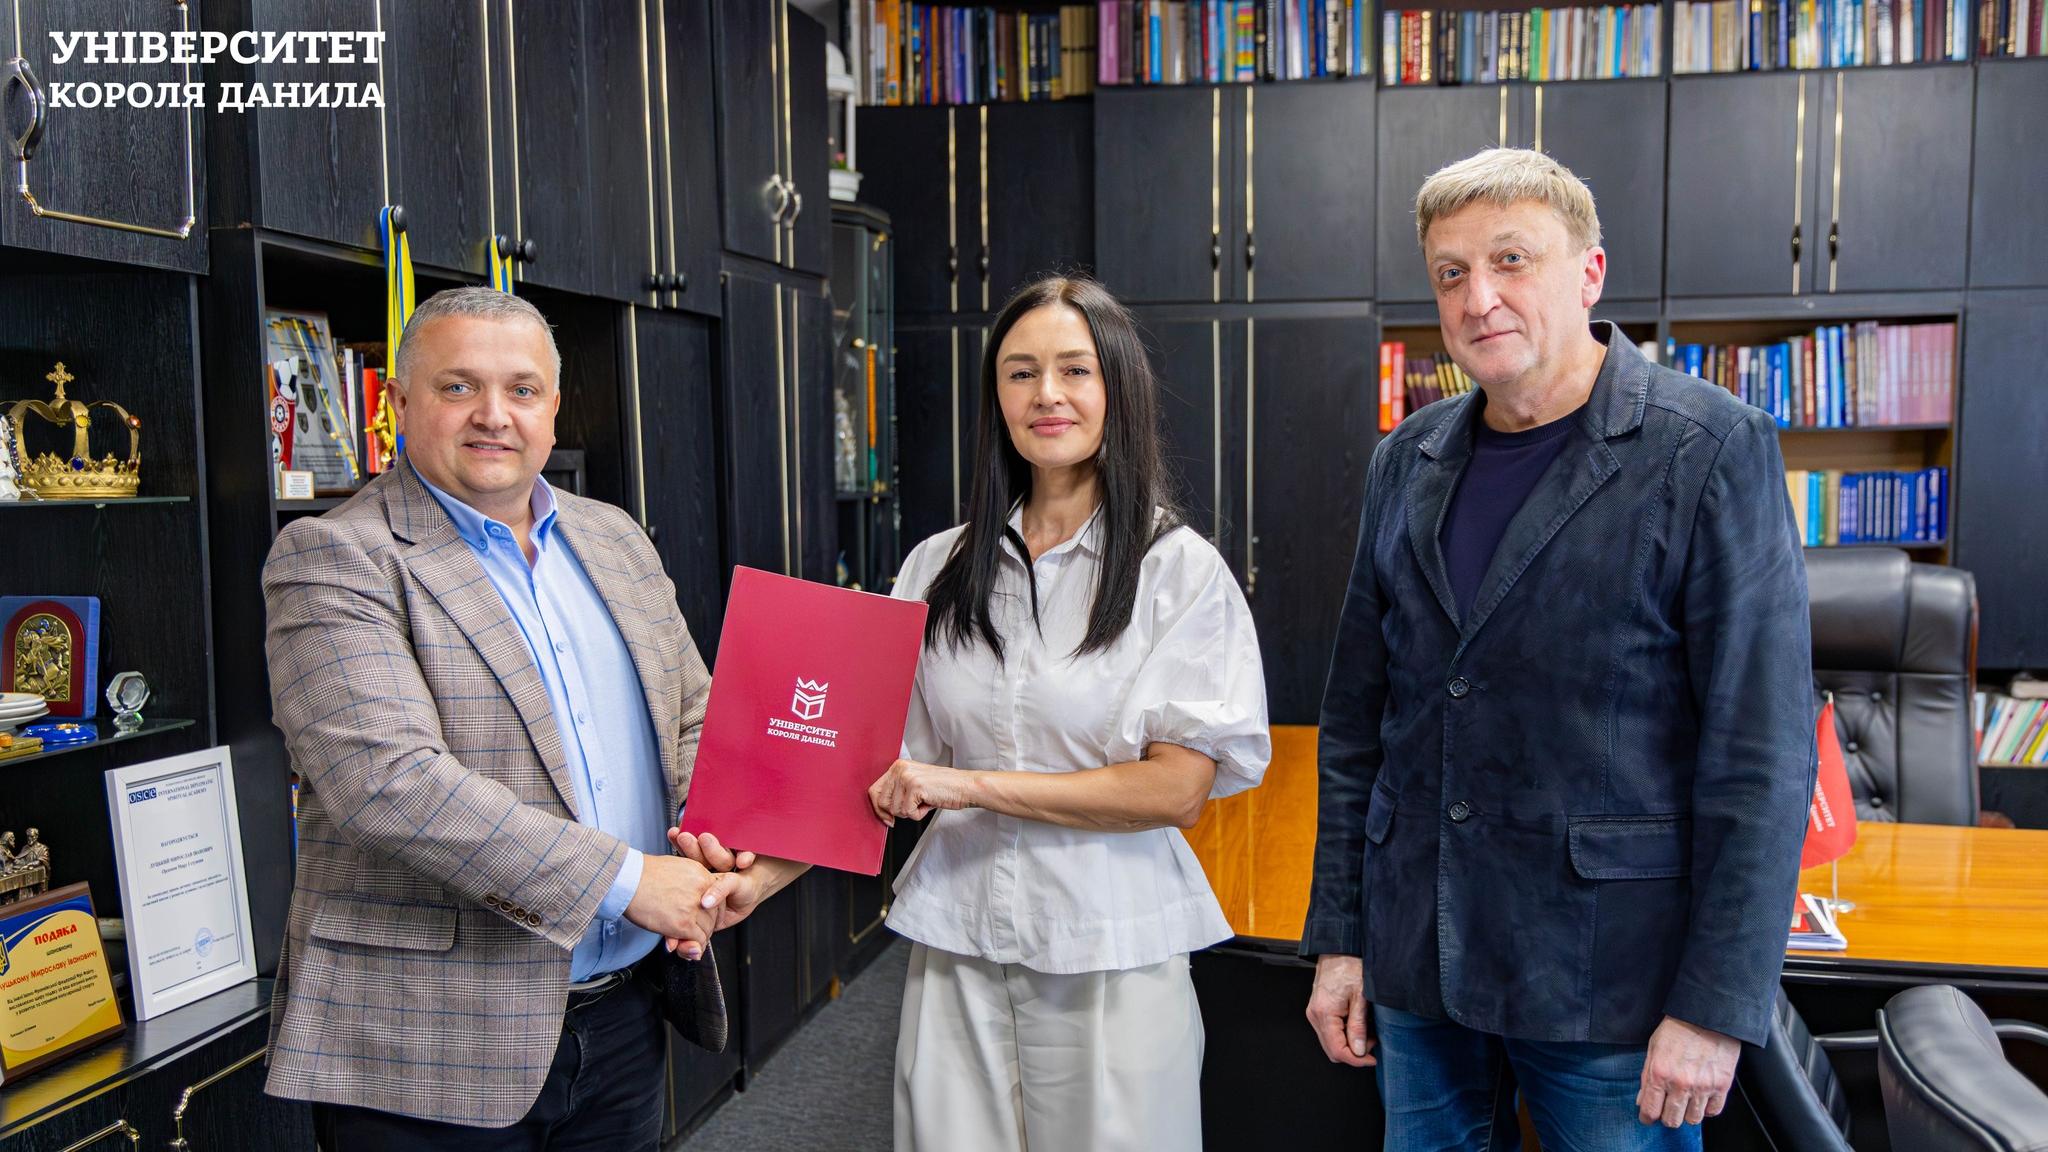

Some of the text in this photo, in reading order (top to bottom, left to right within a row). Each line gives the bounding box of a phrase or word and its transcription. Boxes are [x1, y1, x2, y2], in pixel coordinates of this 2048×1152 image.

[767, 728, 836, 748] КОРОЛЯ ДАНИЛА
[769, 718, 838, 739] УНІВЕРСИТЕТ
[158, 784, 190, 797] INTERNATIONAL
[34, 923, 78, 945] ПОДЯКА
